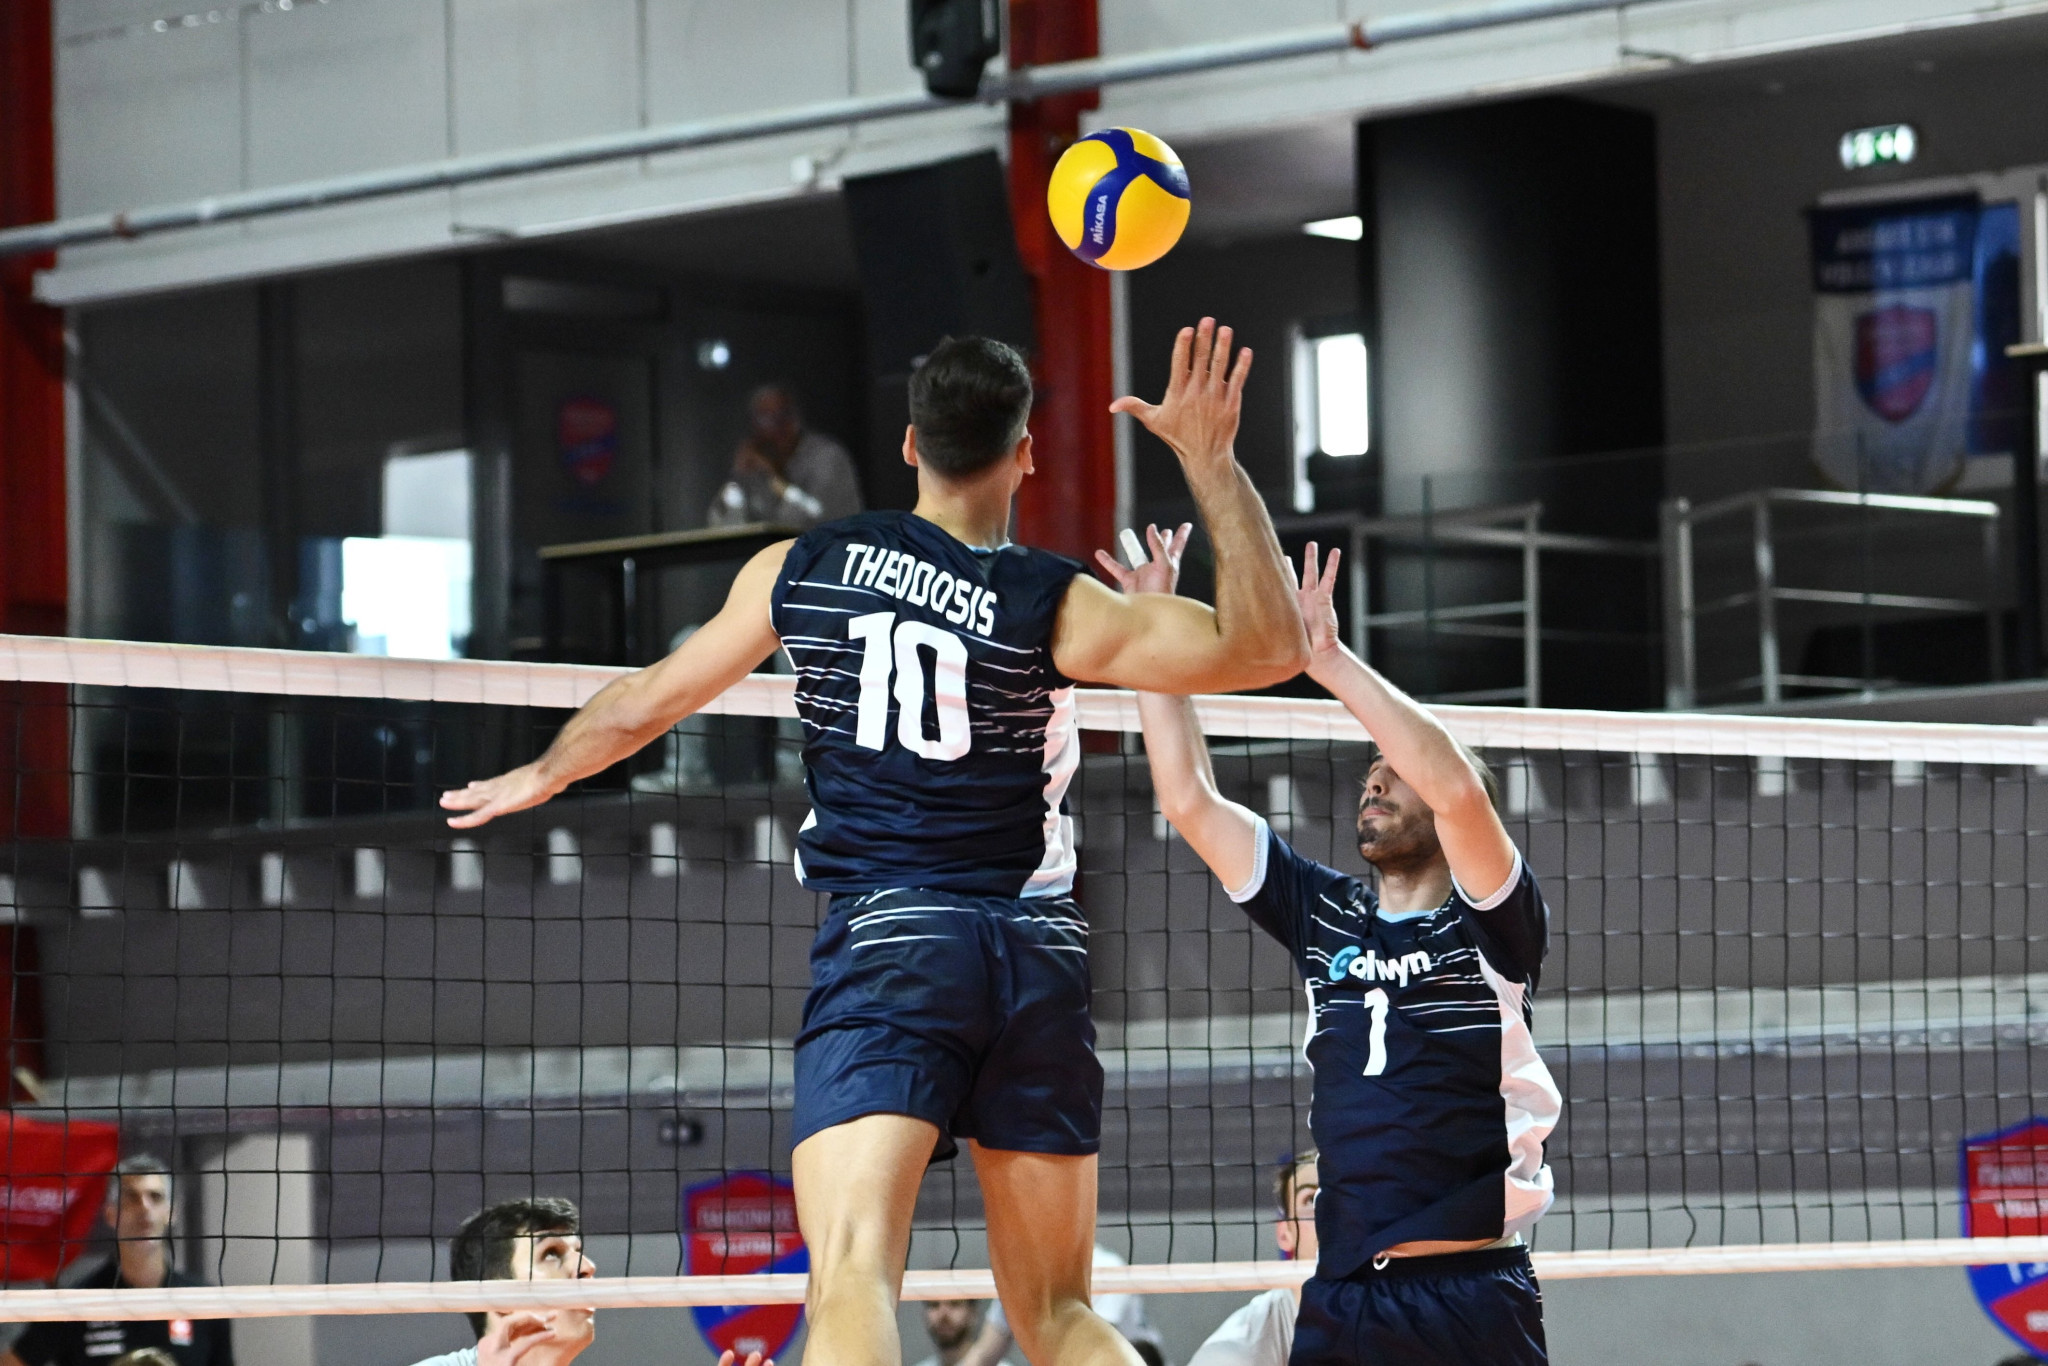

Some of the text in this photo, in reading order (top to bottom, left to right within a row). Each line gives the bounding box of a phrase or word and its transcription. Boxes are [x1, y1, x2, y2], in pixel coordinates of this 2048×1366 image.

[841, 543, 997, 637] THEODOSIS
[848, 611, 972, 761] 10
[1362, 987, 1390, 1076] 1
